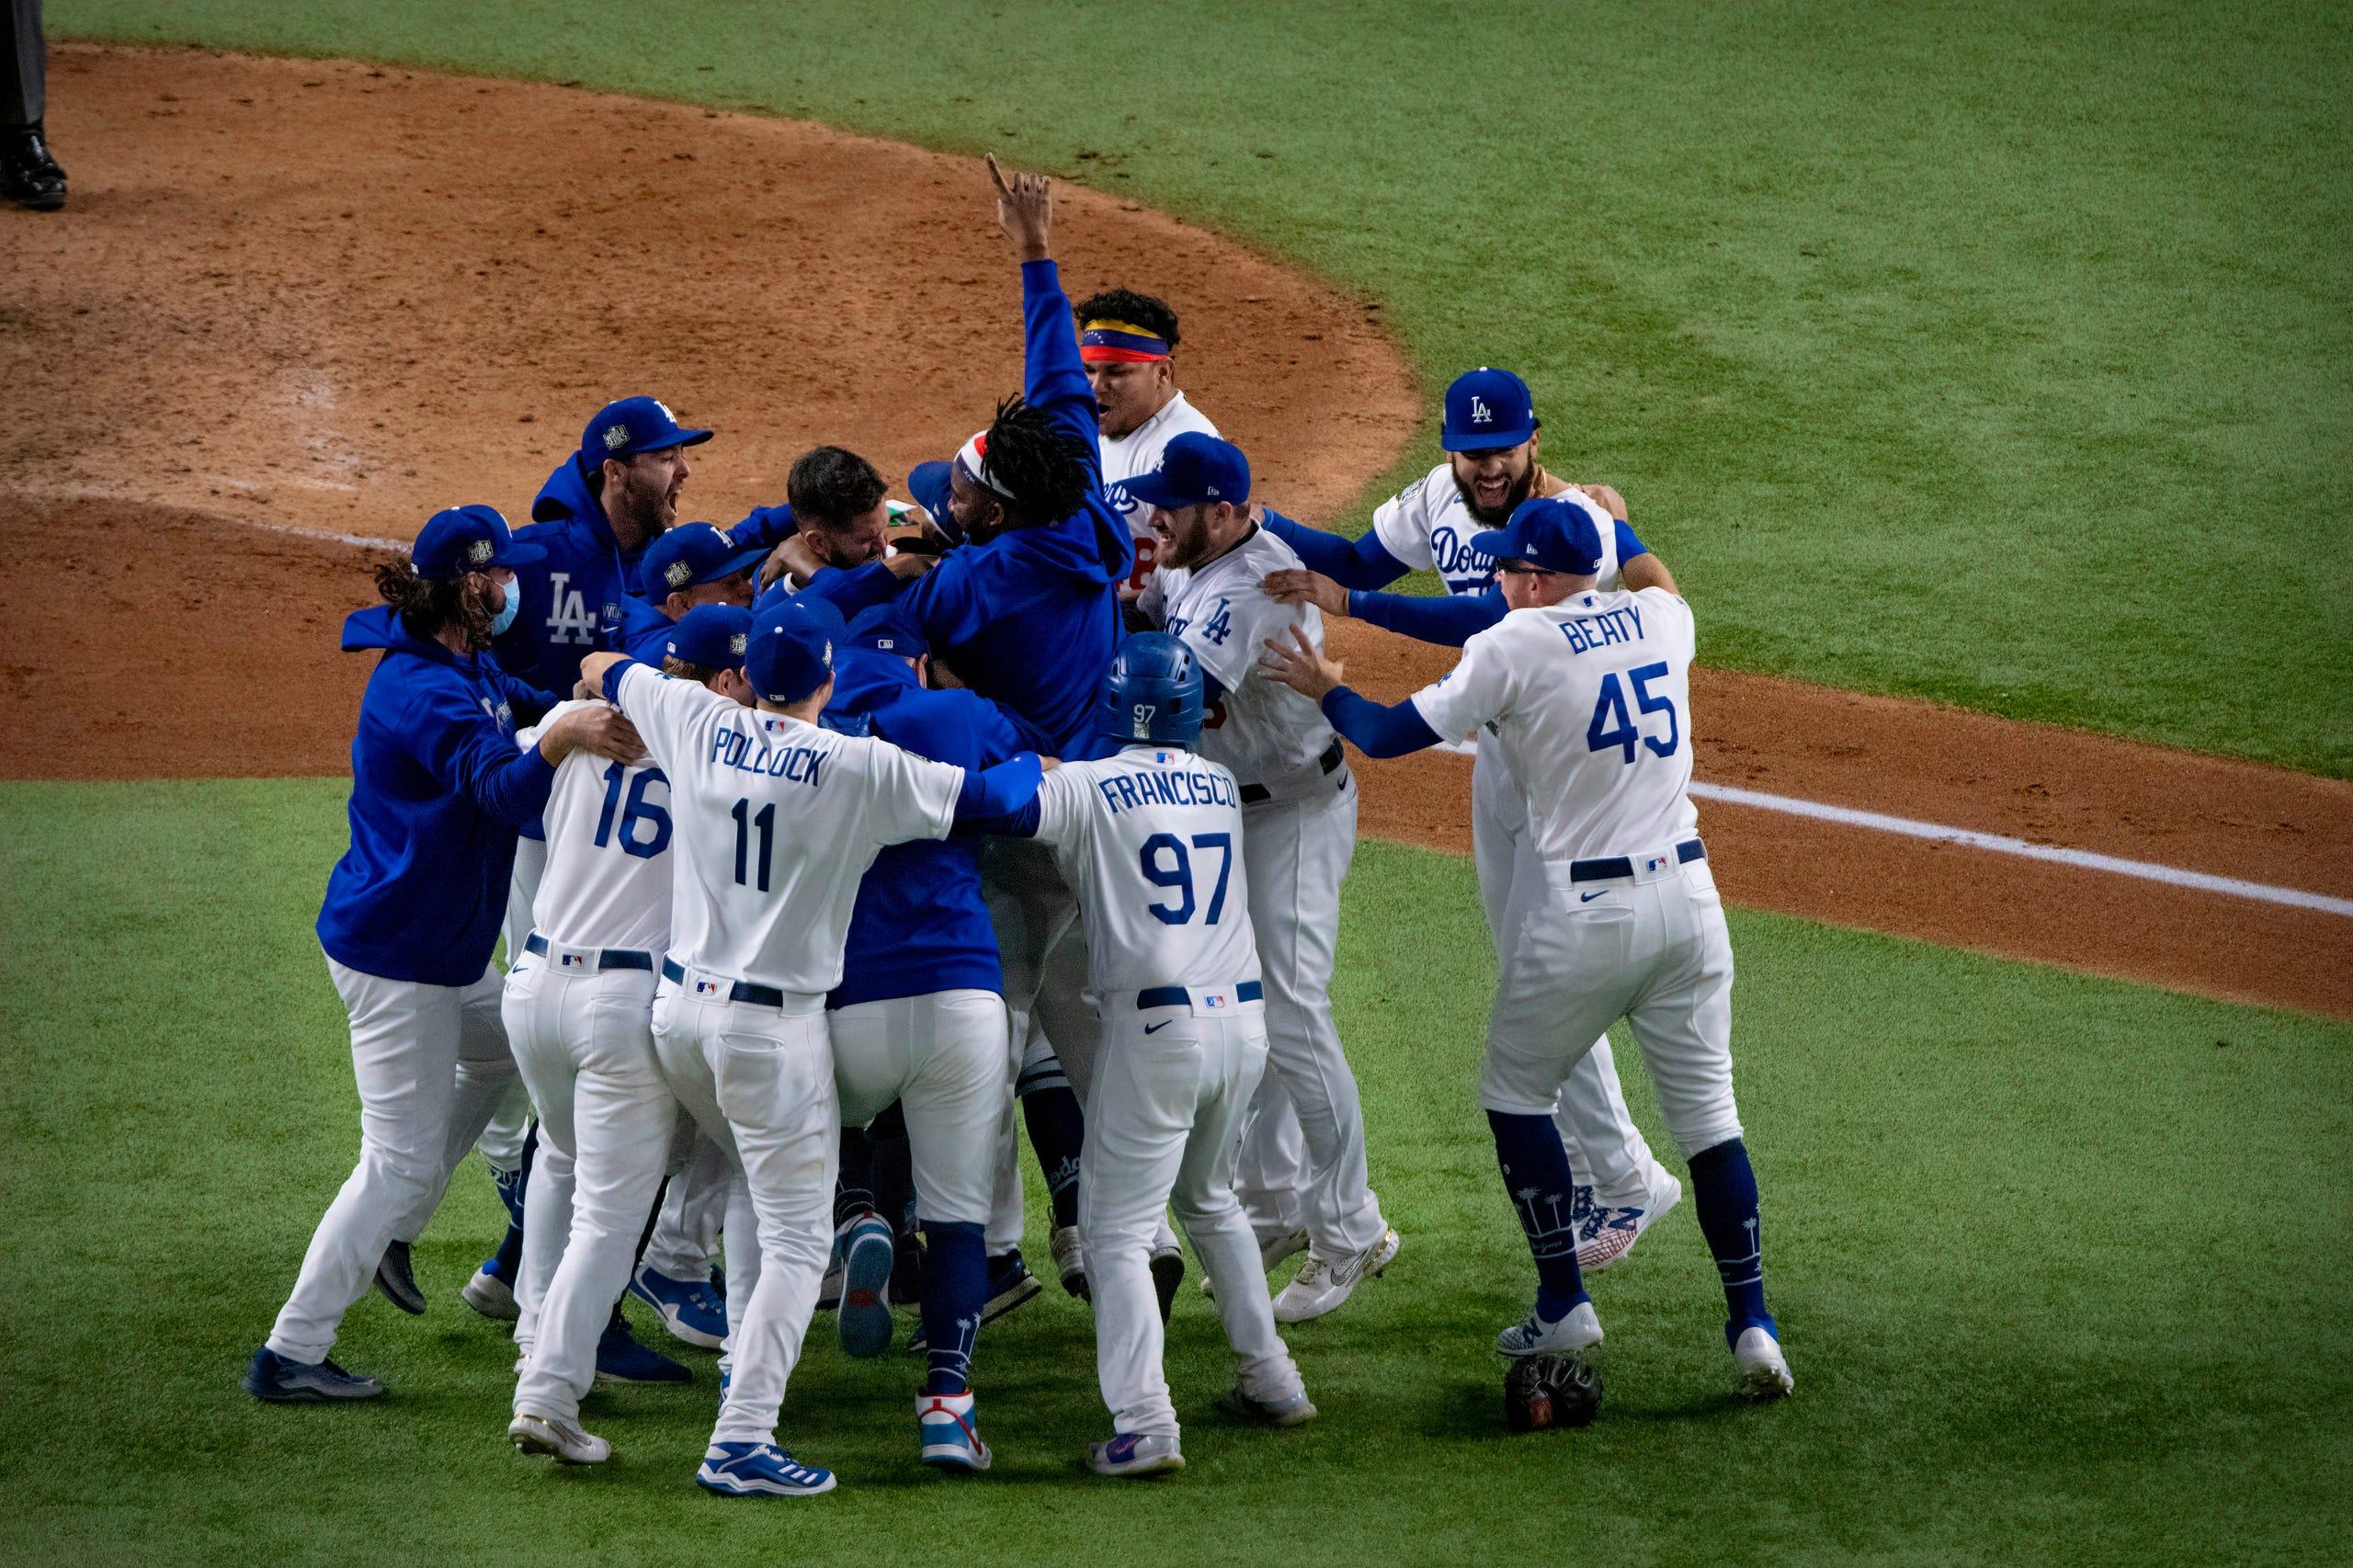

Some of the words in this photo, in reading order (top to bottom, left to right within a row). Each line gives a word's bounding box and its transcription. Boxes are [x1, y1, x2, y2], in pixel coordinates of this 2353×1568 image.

[1472, 396, 1493, 423] LA
[546, 572, 597, 645] LA
[1202, 597, 1232, 646] LA
[1558, 606, 1644, 654] BEATY
[1133, 703, 1156, 724] 97
[1586, 661, 1679, 765] 45
[711, 727, 828, 787] POLLOCK
[594, 761, 674, 859] 16
[1098, 770, 1236, 813] FRANCISCO
[732, 797, 776, 892] 11
[1140, 833, 1233, 926] 97
